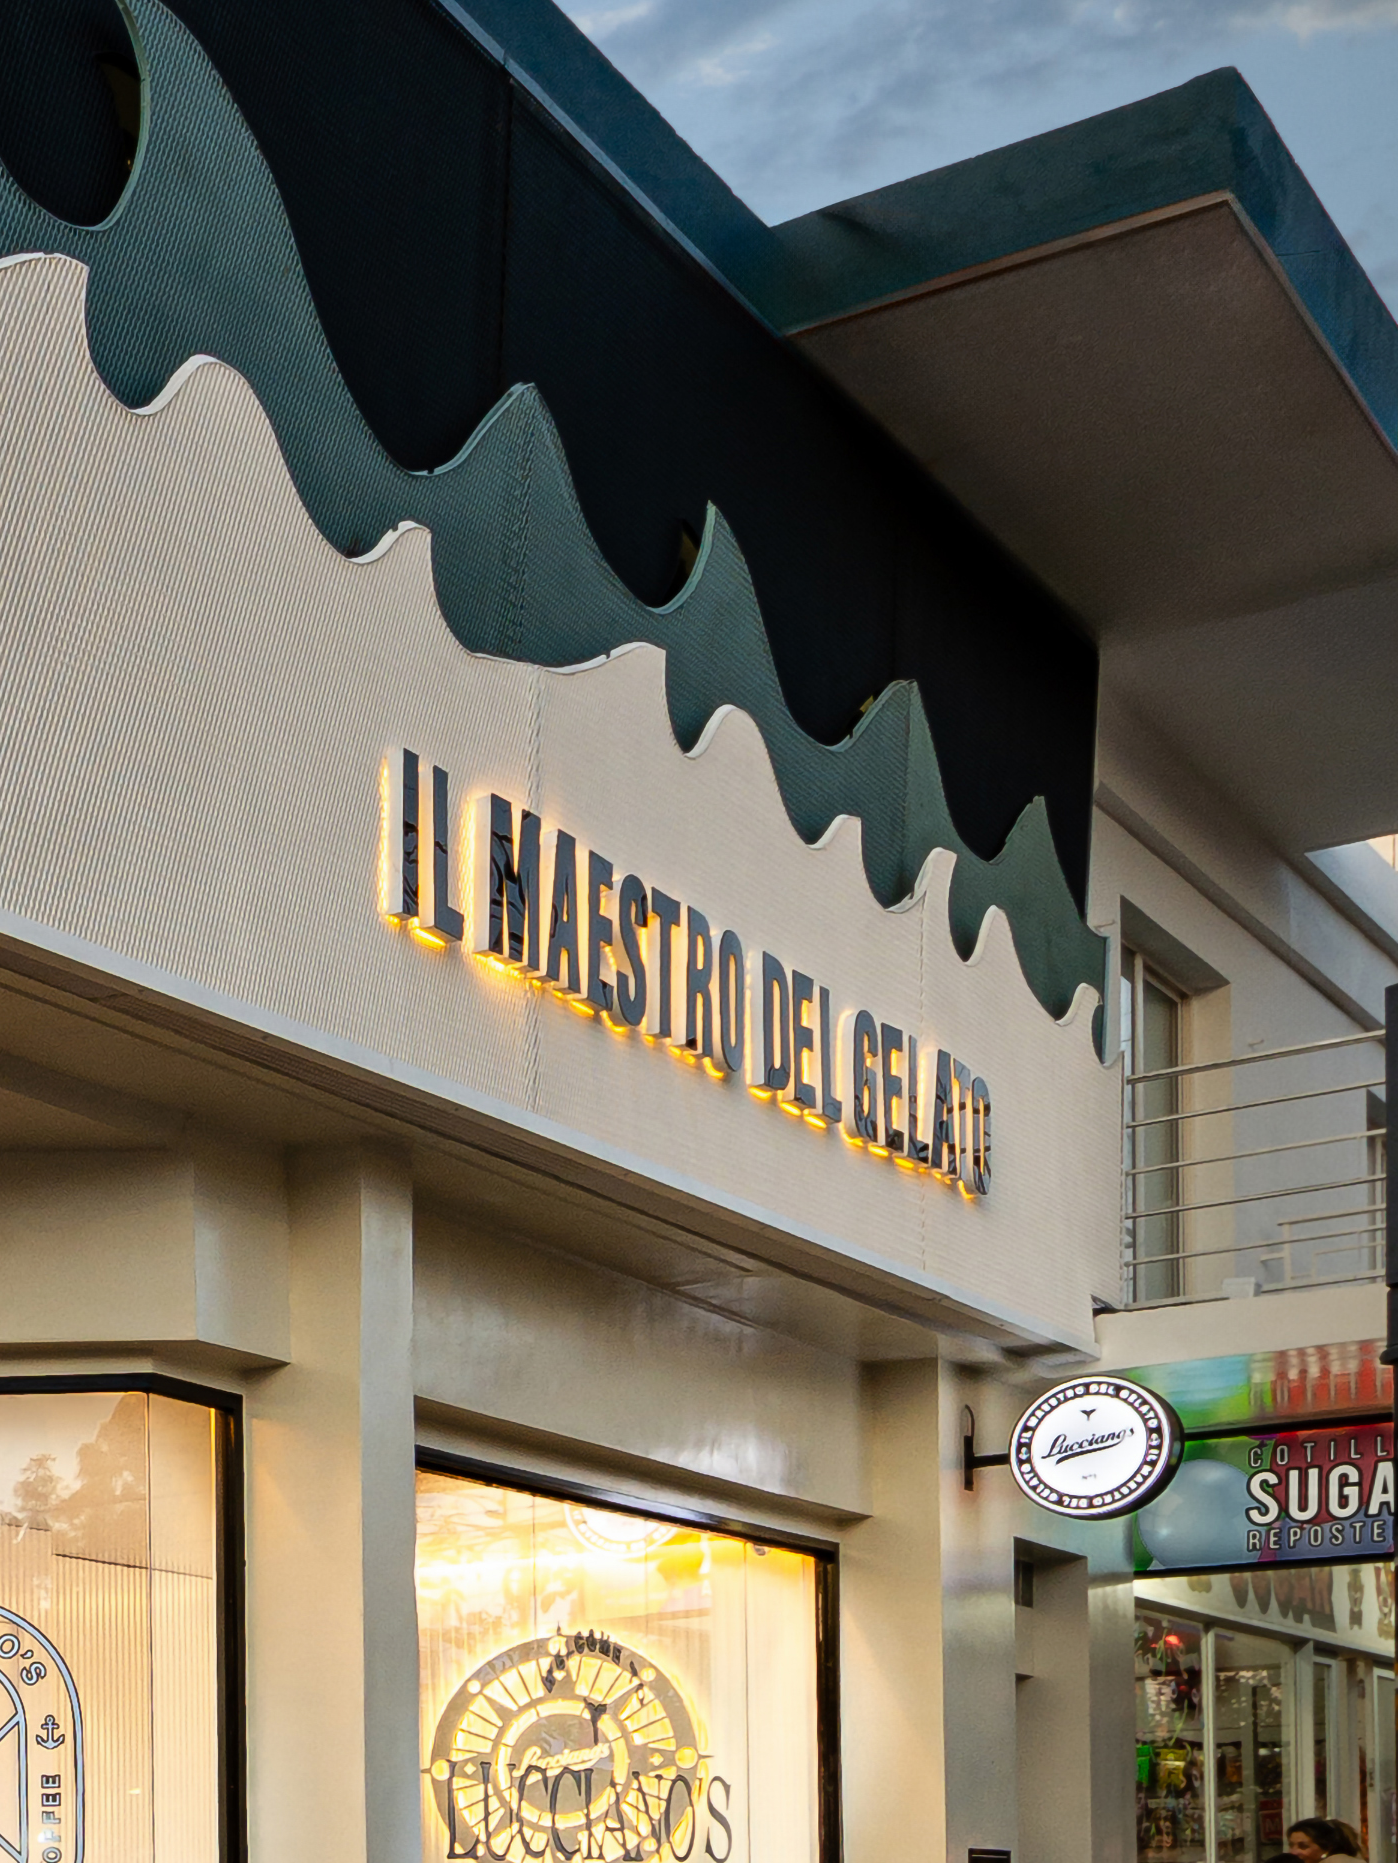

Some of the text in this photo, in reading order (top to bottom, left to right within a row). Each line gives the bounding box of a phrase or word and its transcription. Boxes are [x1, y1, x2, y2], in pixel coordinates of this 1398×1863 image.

[400, 748, 993, 1195] IL MAESTRO DEL GELATO
[1026, 1385, 1086, 1427] MAESTRO
[1089, 1383, 1116, 1395] DEL
[1118, 1389, 1159, 1428] GELATO
[1041, 1427, 1135, 1465] Lucciano's
[1249, 1436, 1389, 1468] COTILL
[1020, 1463, 1059, 1502] GELATO
[1062, 1496, 1089, 1508] DEL
[1092, 1464, 1153, 1507] MAESTRO
[1247, 1461, 1394, 1525] SUGA
[1247, 1521, 1386, 1550] REPOSTE
